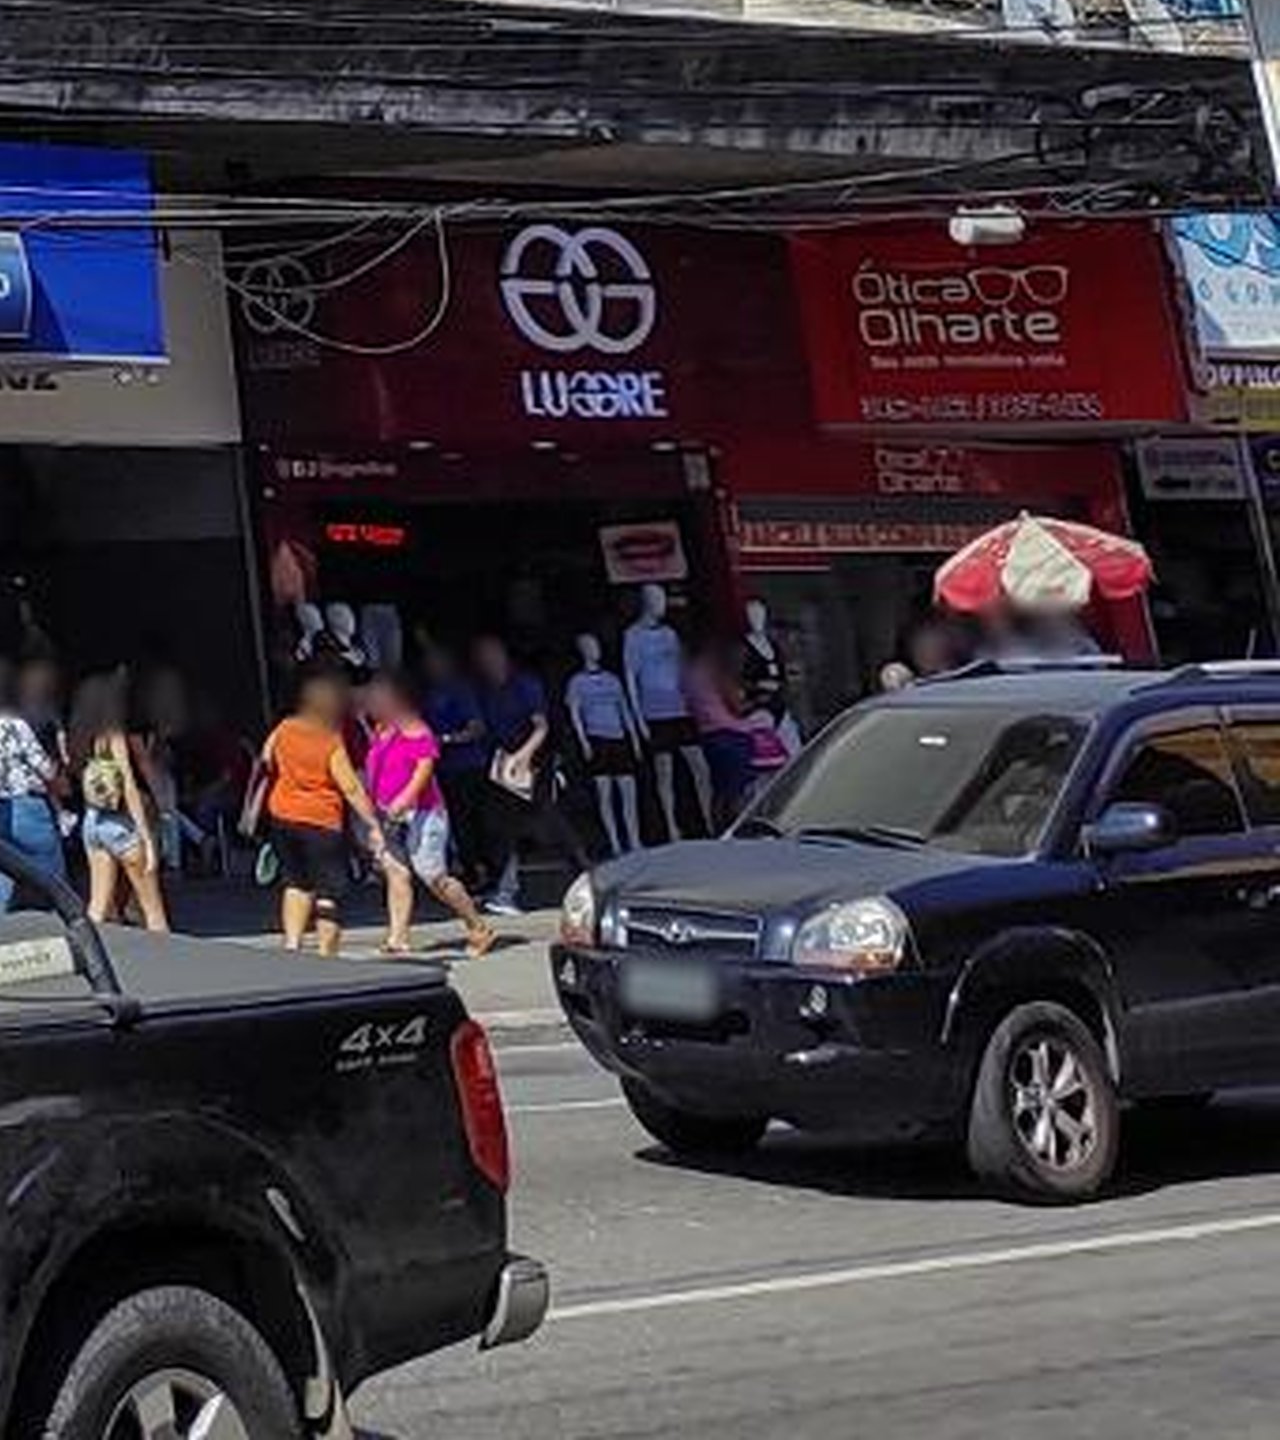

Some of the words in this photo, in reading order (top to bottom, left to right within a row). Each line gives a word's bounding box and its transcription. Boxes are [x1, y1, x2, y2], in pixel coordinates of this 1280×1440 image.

[852, 258, 972, 305] Ótica
[858, 307, 1061, 347] Olharte
[340, 1015, 427, 1053] 4x4
